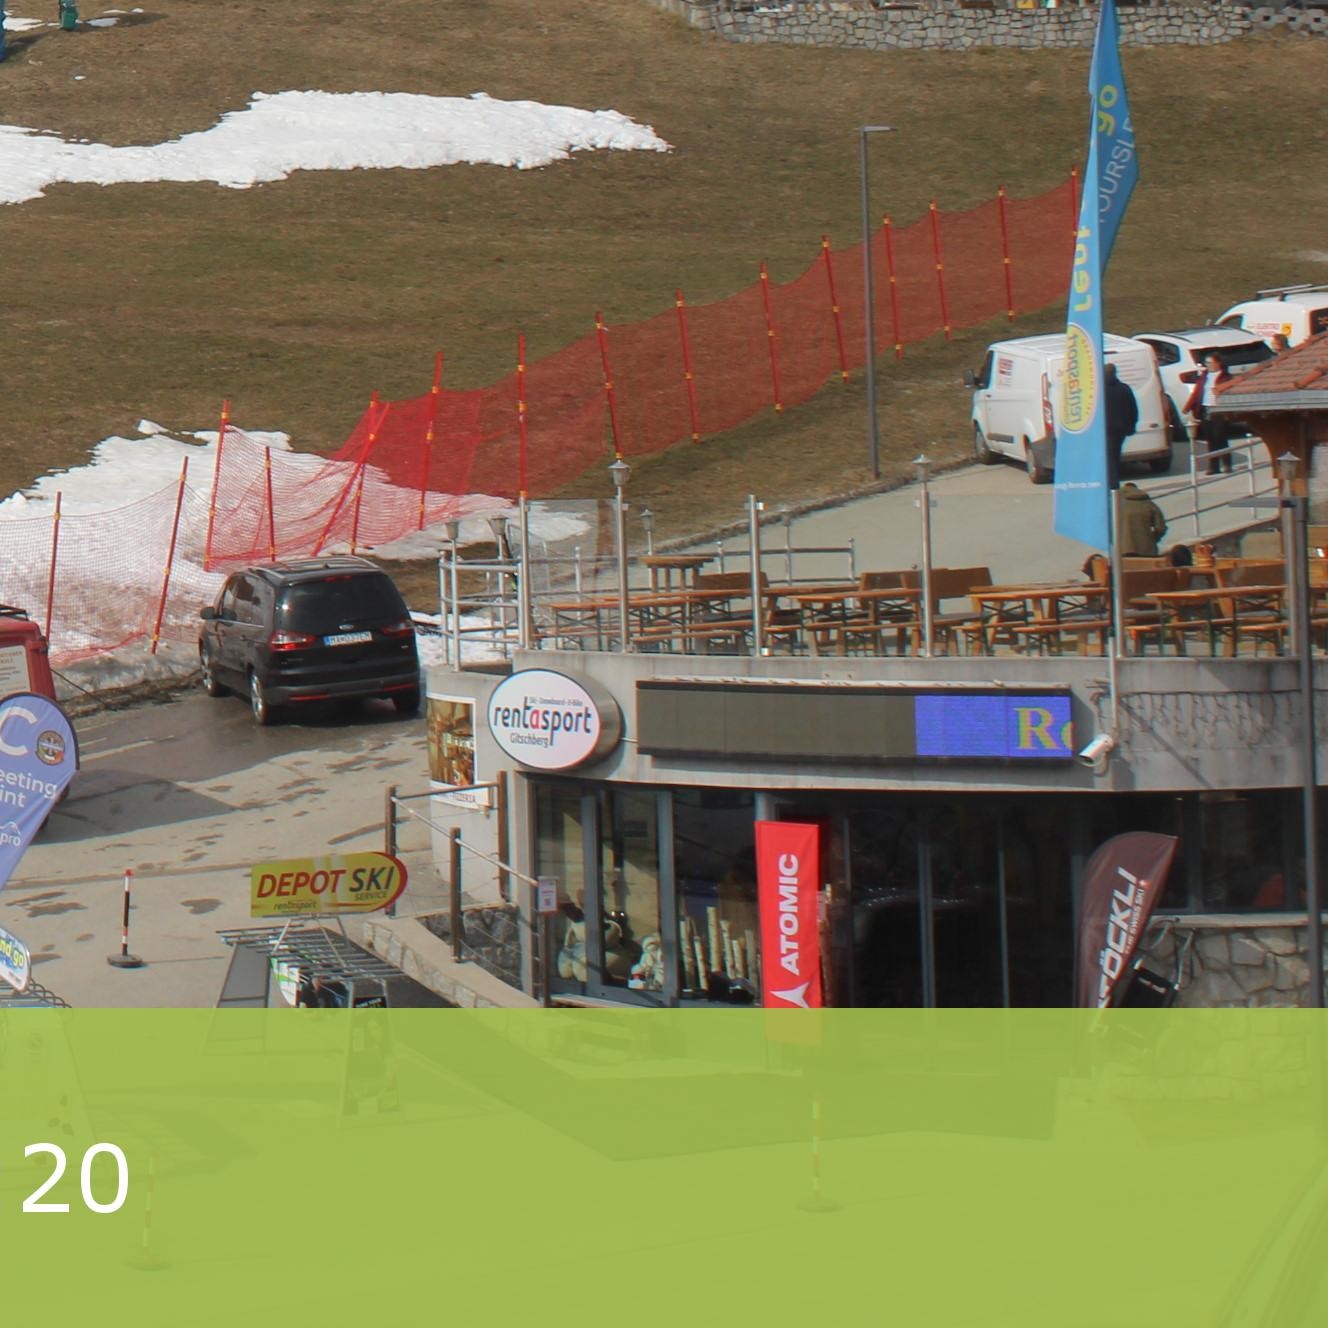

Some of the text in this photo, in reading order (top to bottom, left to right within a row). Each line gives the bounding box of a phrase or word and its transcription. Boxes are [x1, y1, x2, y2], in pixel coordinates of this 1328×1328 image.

[493, 696, 592, 746] rentasport
[510, 732, 549, 748] Gitschberg
[256, 865, 395, 898] DEPOT SKI
[354, 890, 388, 901] SERVICE
[778, 853, 800, 977] ATOMIC
[13, 950, 25, 969] go
